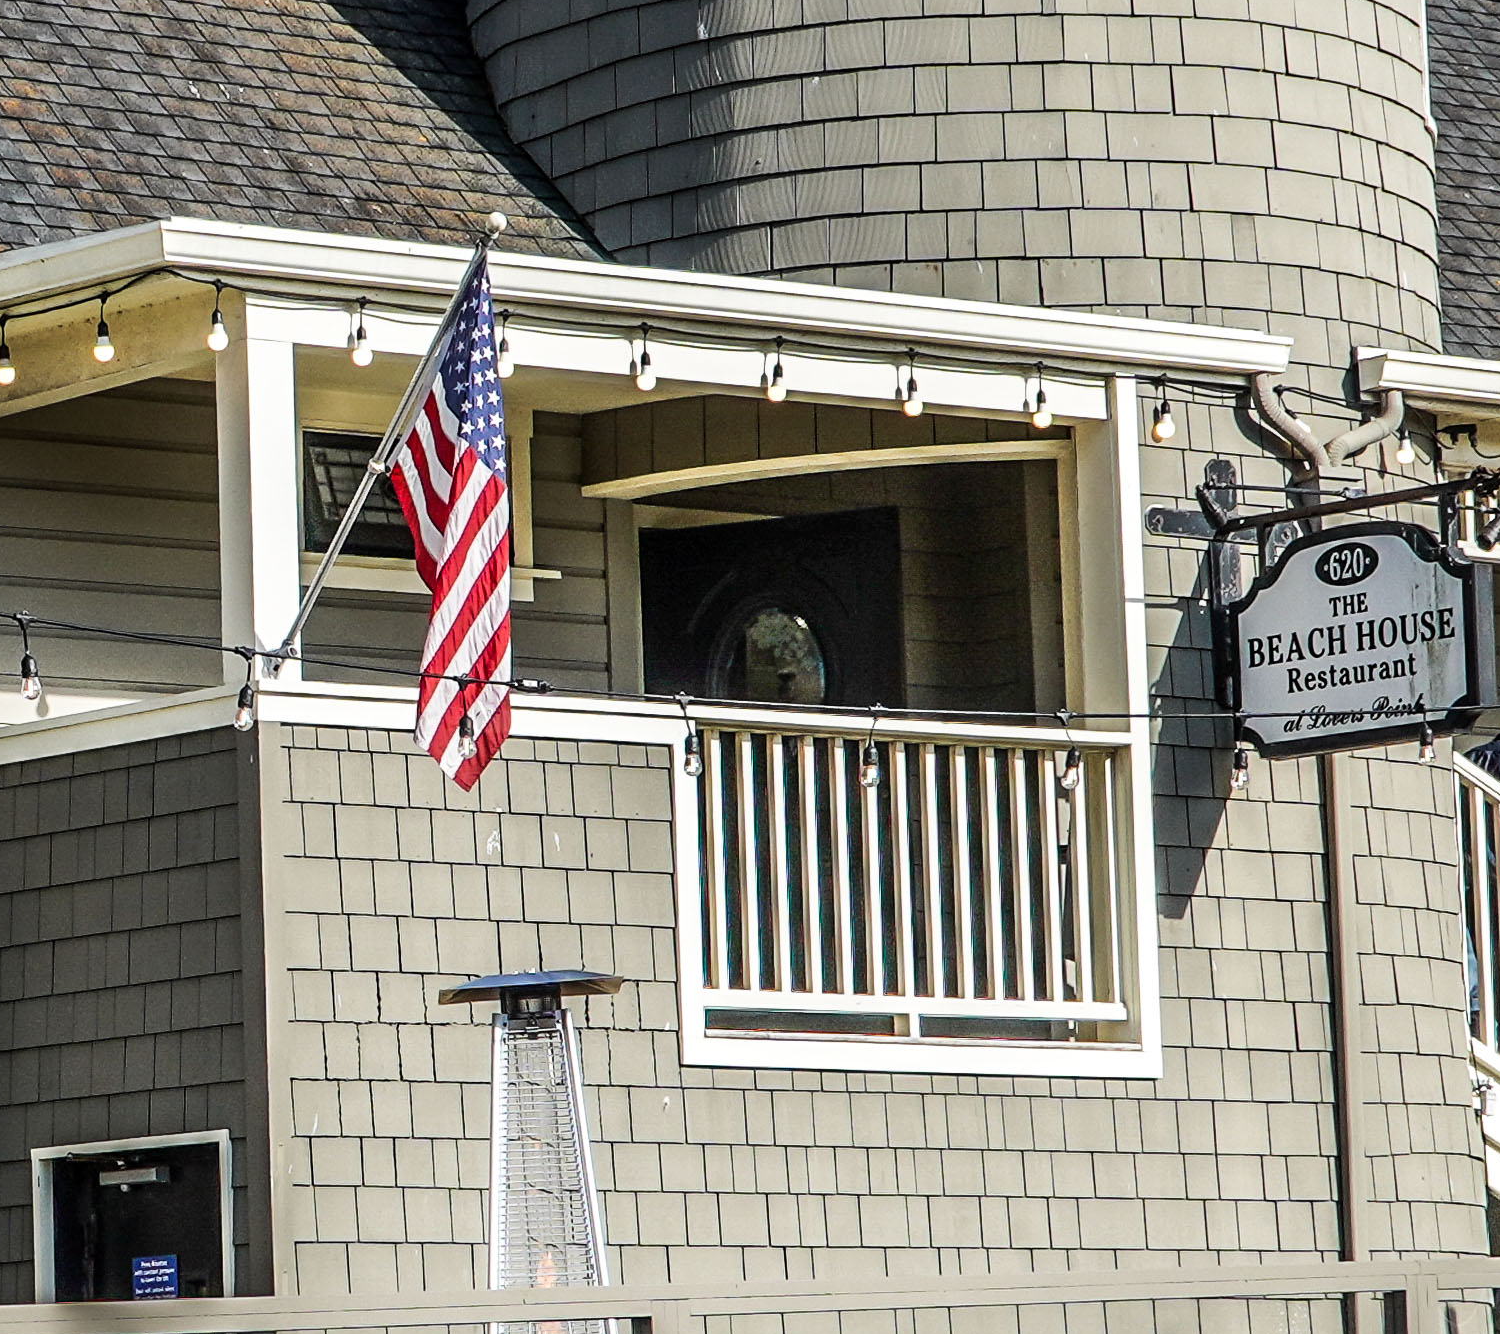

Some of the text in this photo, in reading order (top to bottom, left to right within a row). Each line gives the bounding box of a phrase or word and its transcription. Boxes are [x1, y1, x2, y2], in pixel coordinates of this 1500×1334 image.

[1329, 547, 1364, 581] 620
[1328, 592, 1369, 618] THE
[1247, 607, 1456, 669] BEACH HOUSE
[1286, 652, 1418, 694] Restaurant
[1283, 693, 1426, 733] at Lovers Point
